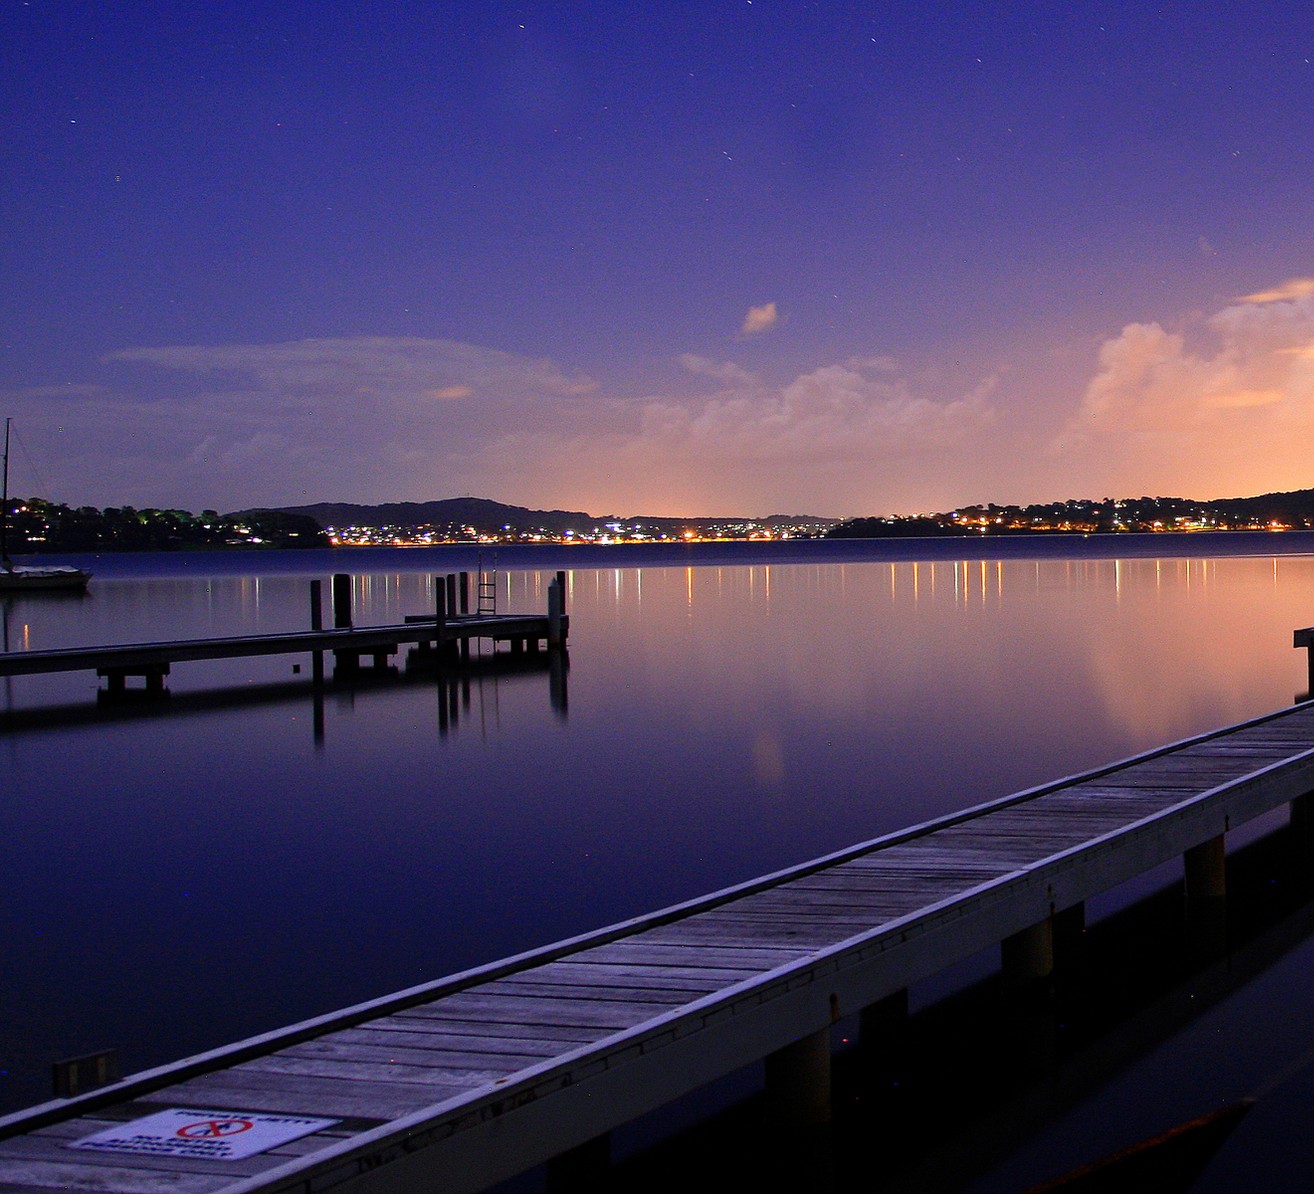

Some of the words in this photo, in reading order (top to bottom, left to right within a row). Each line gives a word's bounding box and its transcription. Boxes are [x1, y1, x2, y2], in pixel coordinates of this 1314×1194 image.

[175, 1111, 253, 1120] PRIVATE
[257, 1117, 317, 1125] JETTY
[166, 1137, 230, 1145] ENTRY
